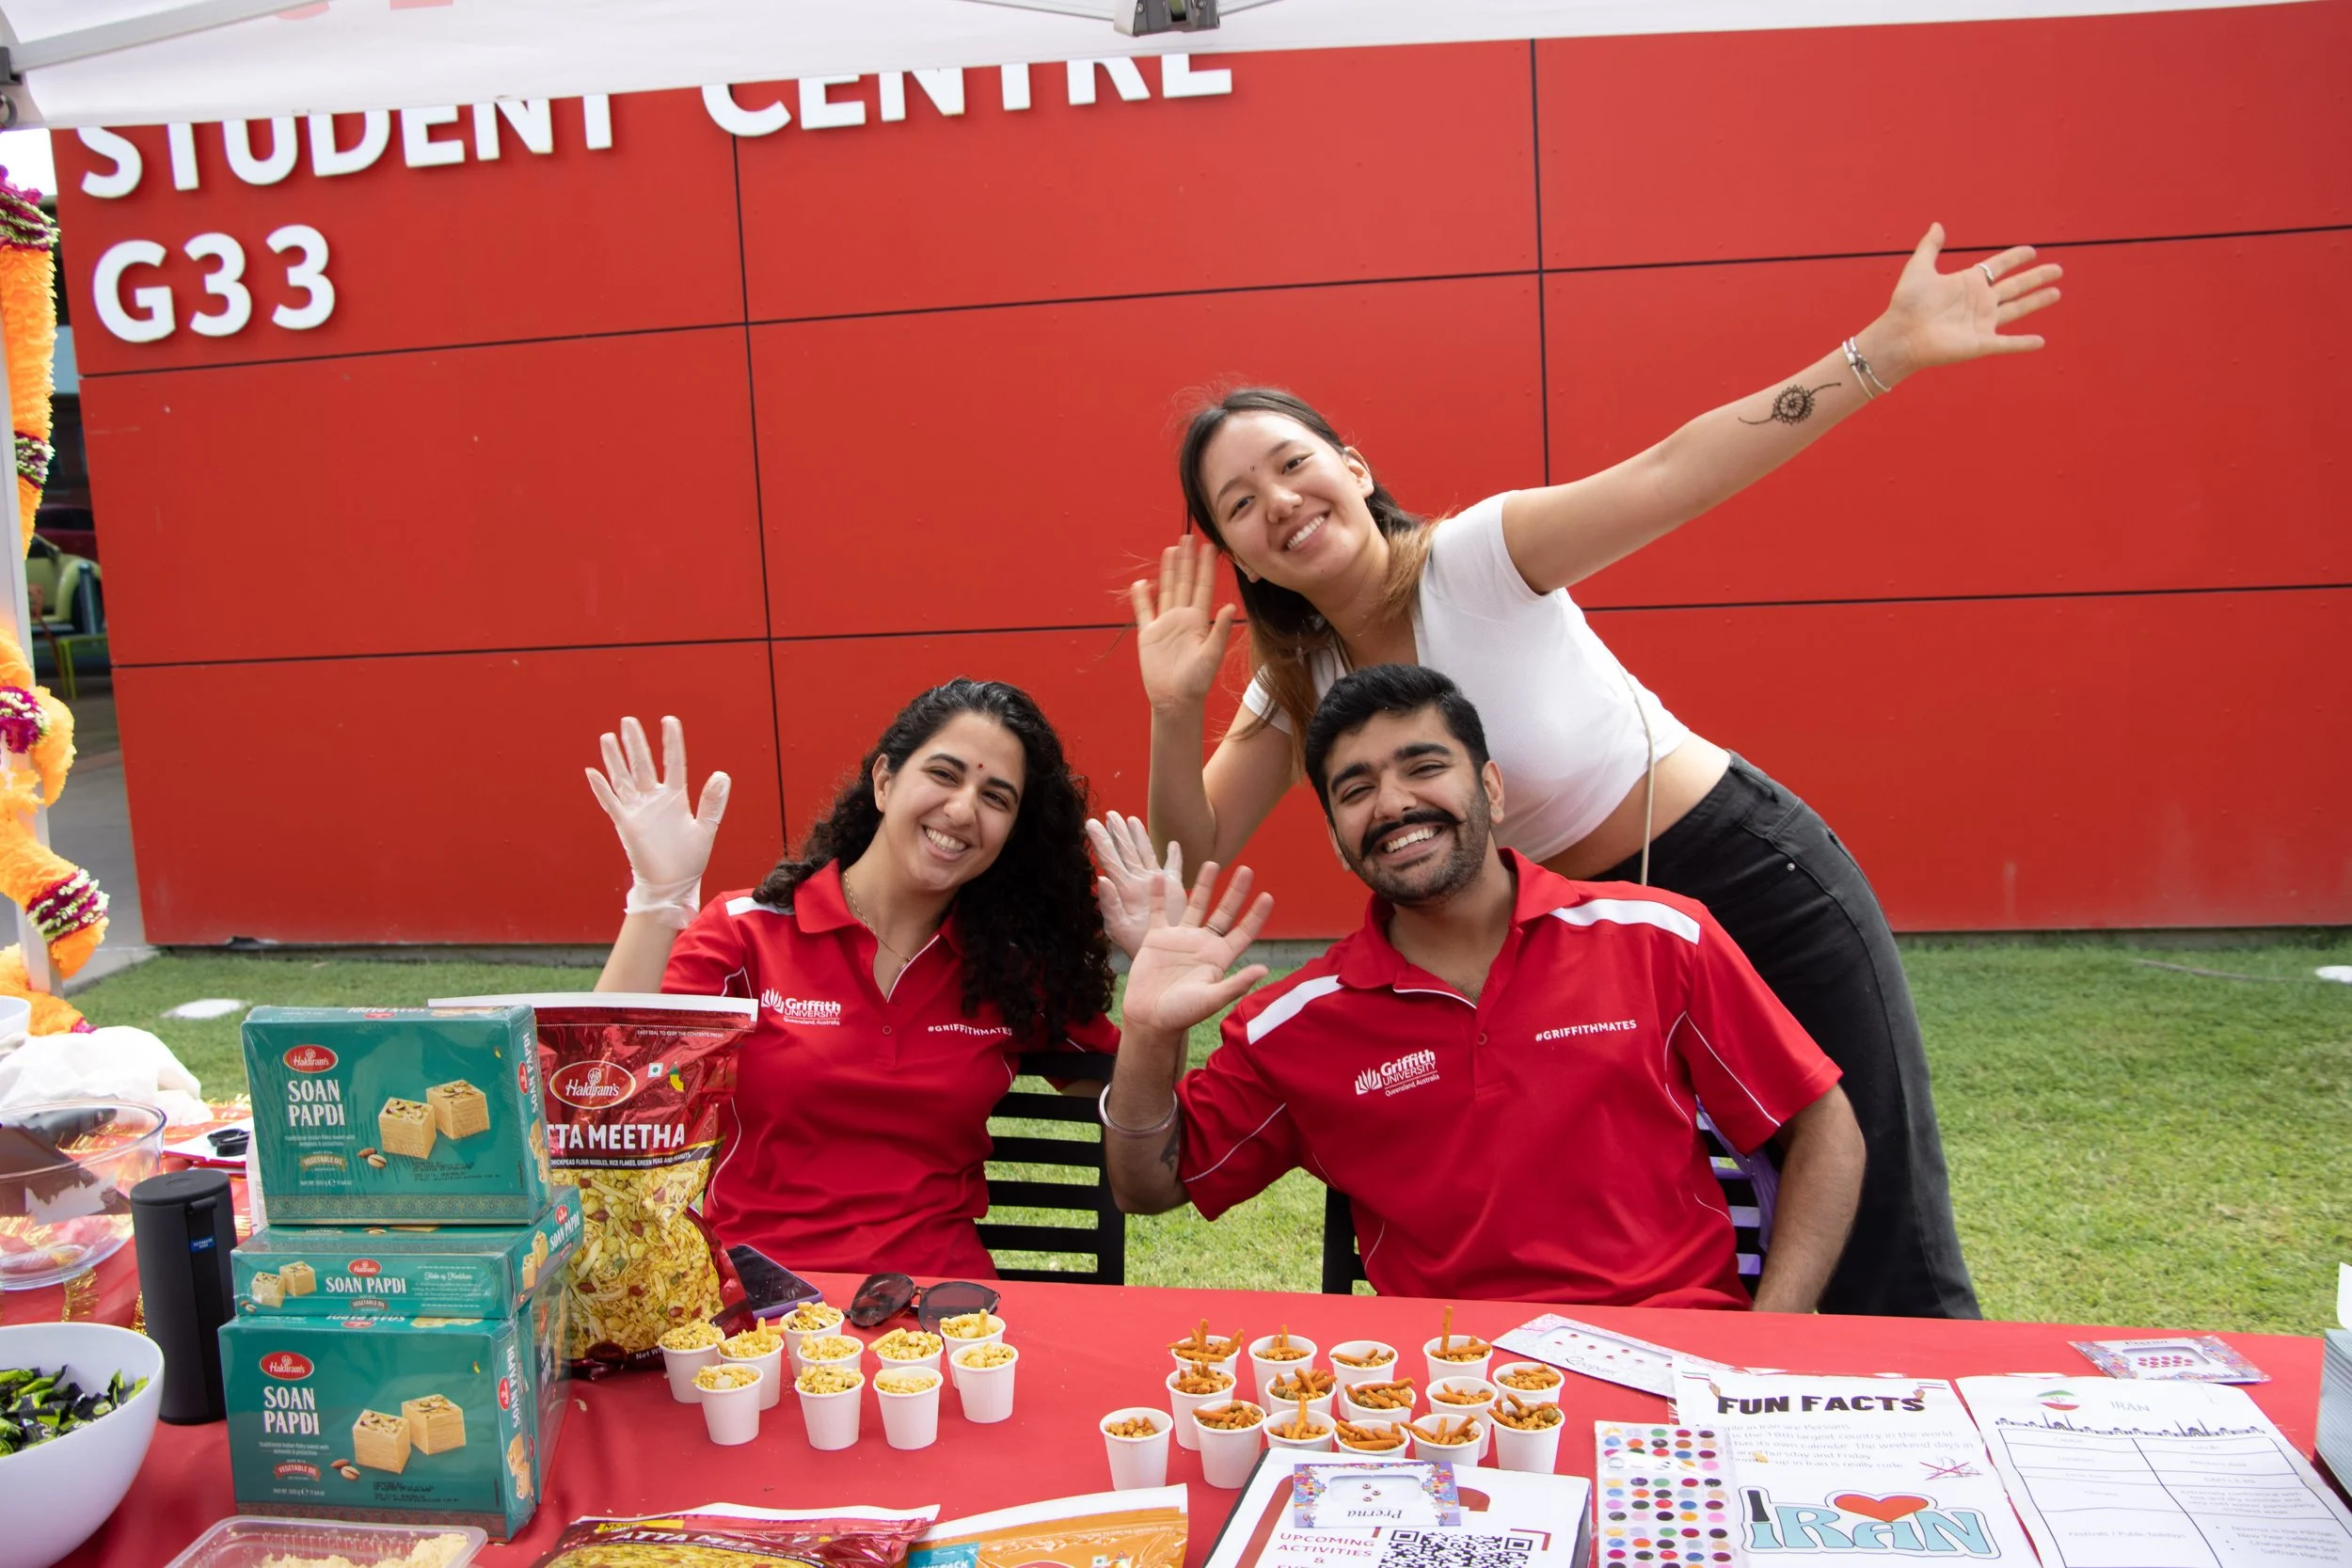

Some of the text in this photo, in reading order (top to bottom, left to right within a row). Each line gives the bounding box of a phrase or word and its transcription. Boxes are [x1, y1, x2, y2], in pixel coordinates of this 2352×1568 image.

[93, 224, 336, 343] G33
[784, 1006, 840, 1018] UNIVERSITY
[785, 997, 841, 1012] Griffith
[928, 1022, 1013, 1037] #GRIFFITHMATES
[1535, 1020, 1637, 1042] #GRIFFITHMATES
[293, 1054, 329, 1067] Haldiram's
[1380, 1049, 1436, 1077] Griffith
[1382, 1060, 1436, 1086] UNIVERSITY
[1416, 1073, 1440, 1087] Australia
[288, 1079, 341, 1102] SOAN
[565, 1078, 620, 1097] Haldiram's
[288, 1103, 345, 1127] PAPDI
[589, 1123, 685, 1150] MEETHA
[653, 1157, 662, 1165] PEAS
[326, 1276, 363, 1293] SOAN
[366, 1276, 406, 1294] PAPDI
[269, 1361, 306, 1374] Haldiram's
[262, 1386, 316, 1411] SOAN
[1717, 1395, 1926, 1415] FUN FACTS
[2109, 1400, 2151, 1413] IRAN
[263, 1410, 321, 1435] PAPDI
[1920, 1430, 1954, 1438] world
[1933, 1441, 1961, 1450] days
[278, 1464, 317, 1476] VEGETABLE OIL
[1346, 1509, 1403, 1520] Prerna
[1279, 1532, 1375, 1546] UPCOMING
[1278, 1544, 1373, 1557] ACTIVITIES
